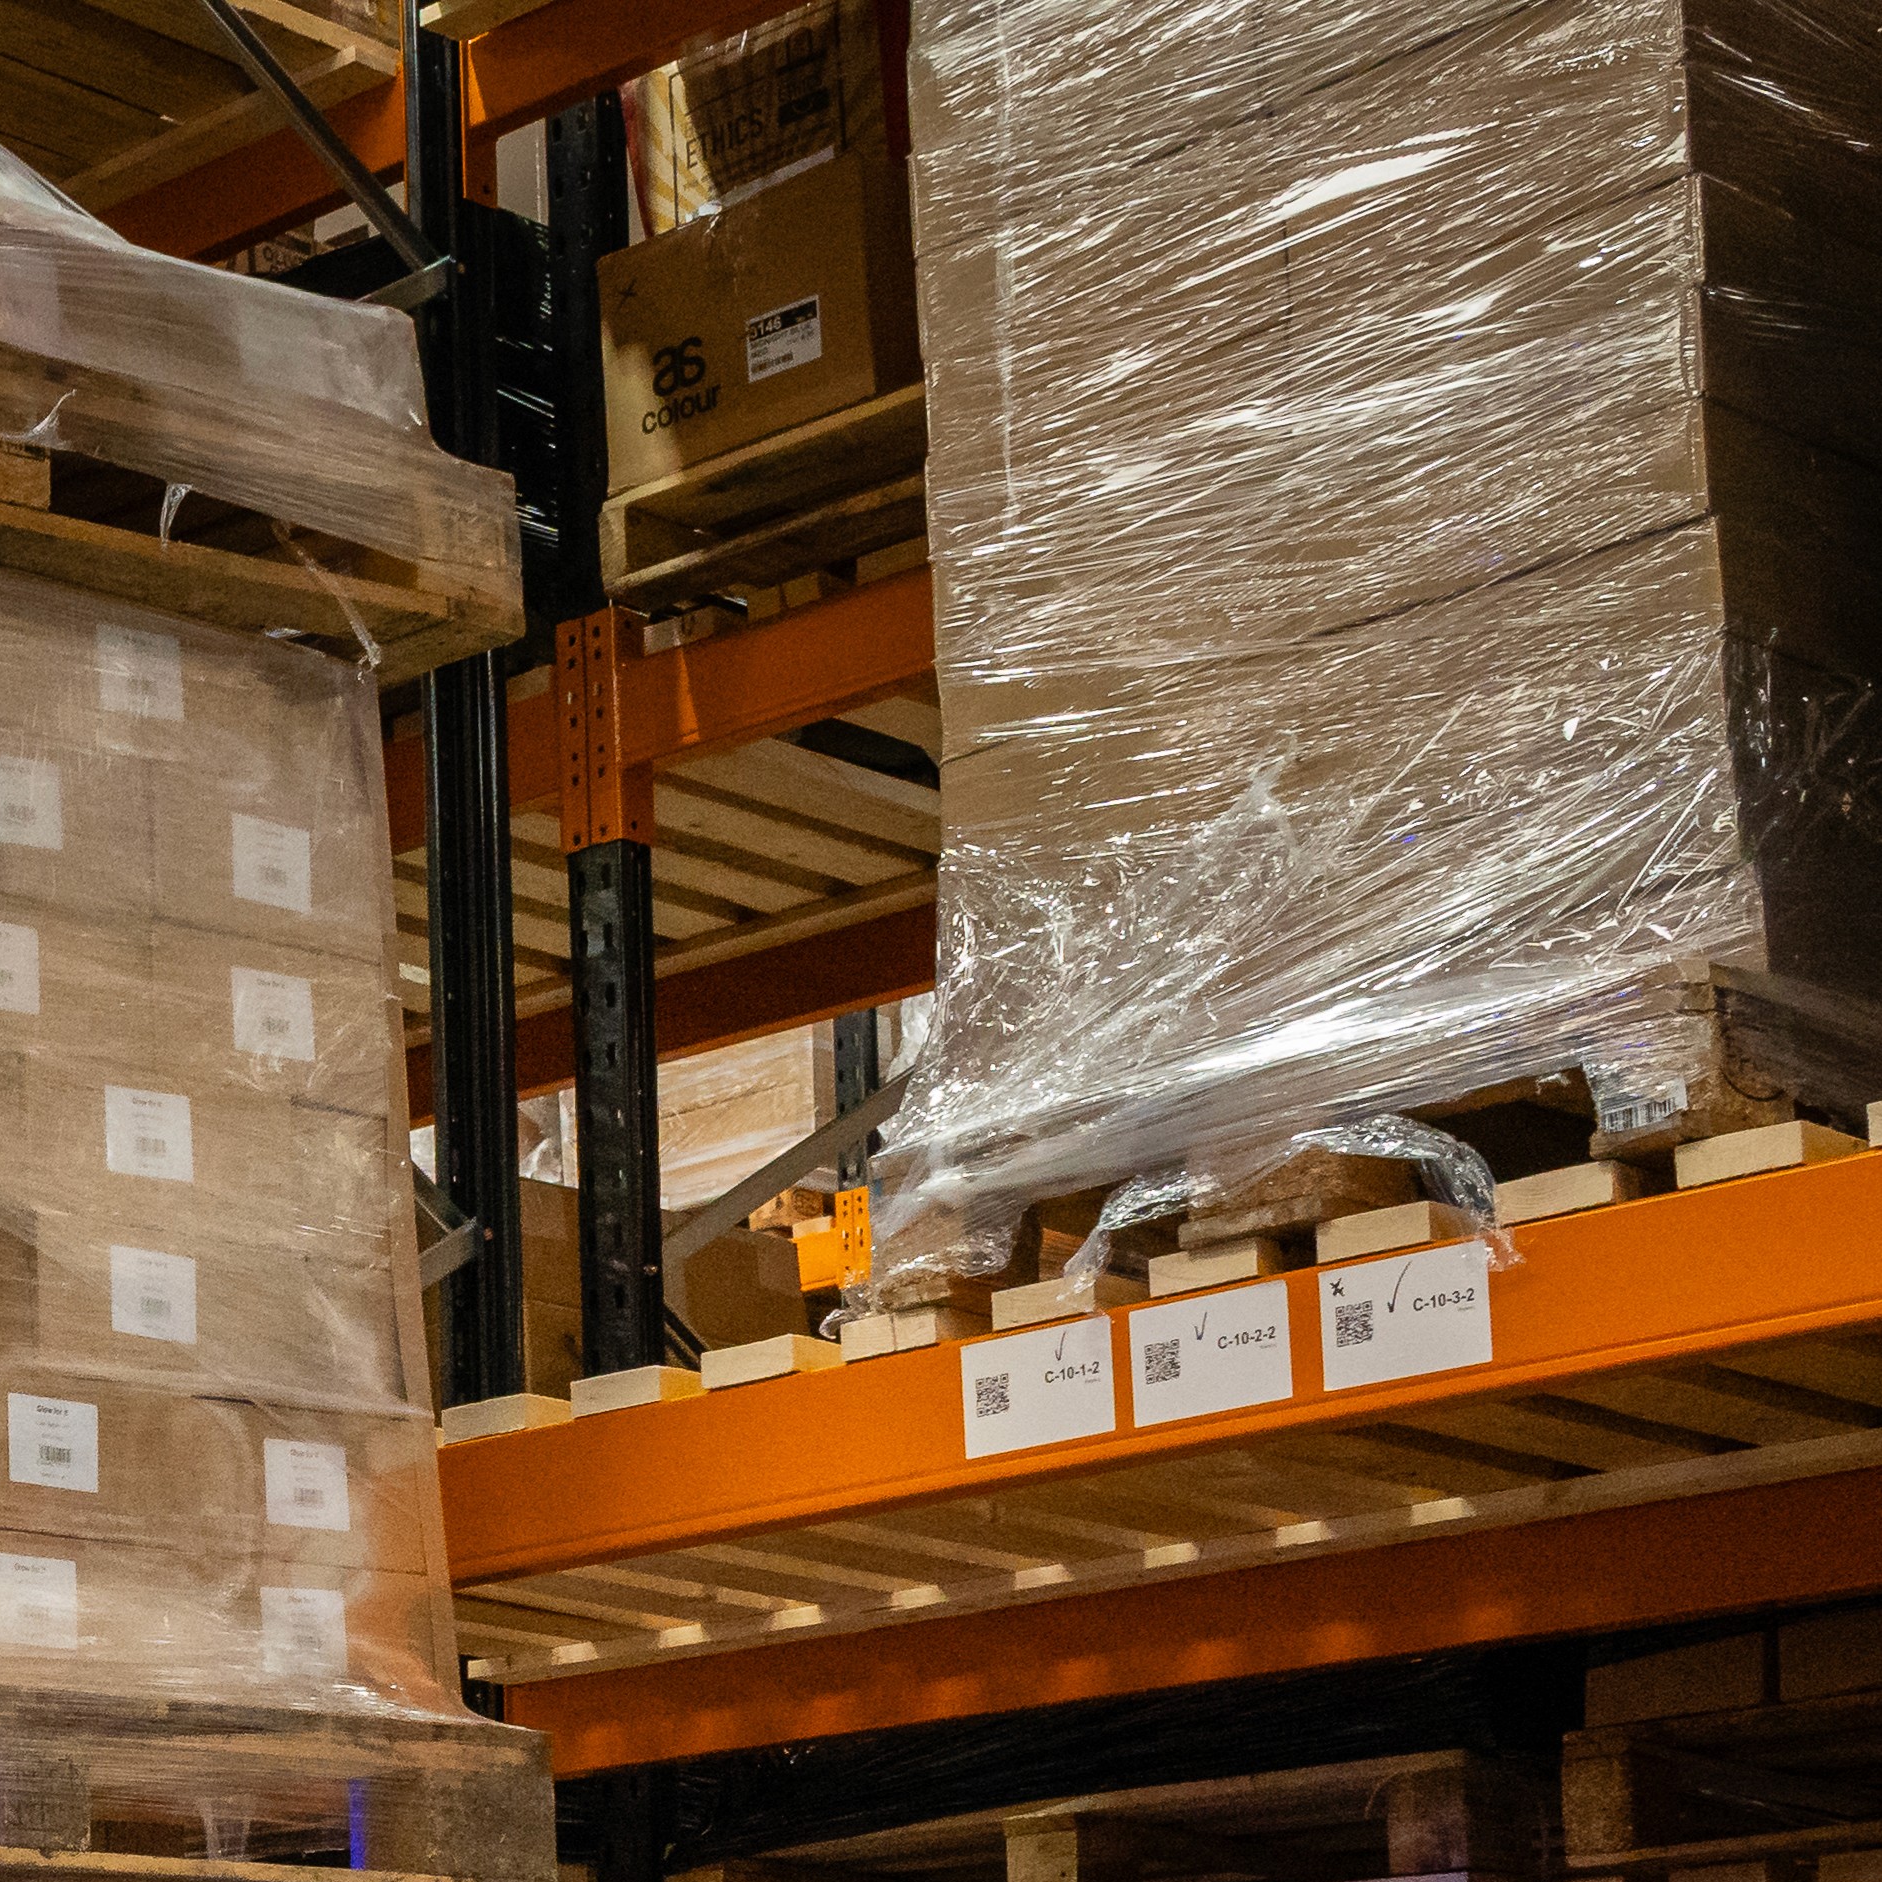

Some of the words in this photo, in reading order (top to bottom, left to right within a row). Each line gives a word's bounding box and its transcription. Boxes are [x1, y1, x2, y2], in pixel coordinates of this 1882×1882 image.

[641, 381, 721, 436] colour
[1413, 1288, 1474, 1311] C-10-3-2
[1217, 1326, 1276, 1349] C-10-2-2
[1045, 1361, 1099, 1383] C-10-1-2
